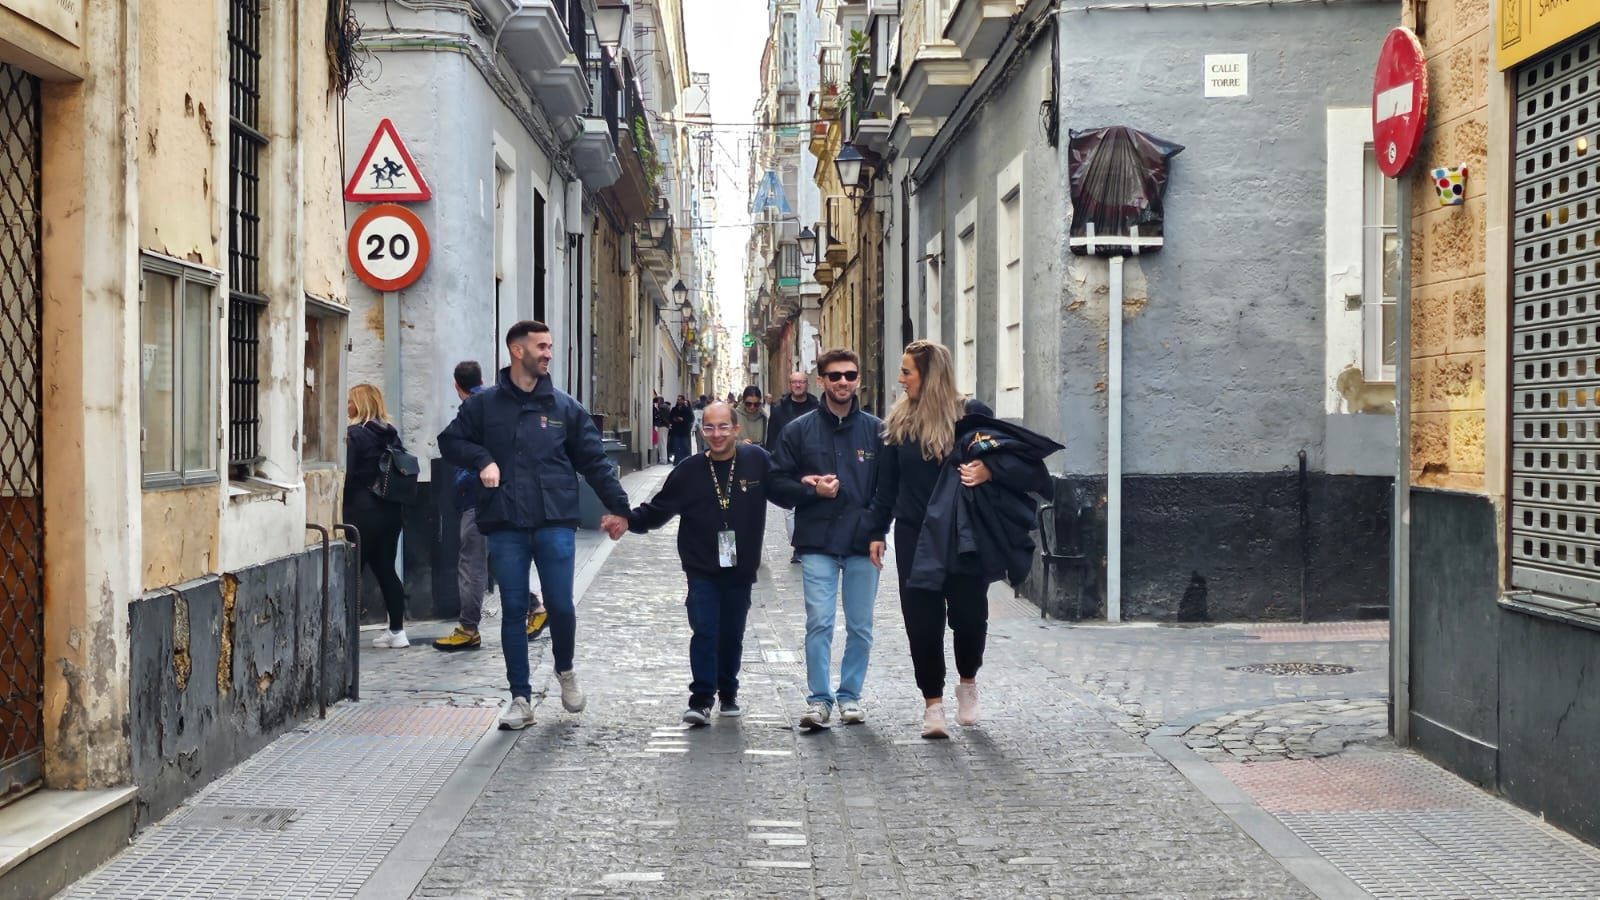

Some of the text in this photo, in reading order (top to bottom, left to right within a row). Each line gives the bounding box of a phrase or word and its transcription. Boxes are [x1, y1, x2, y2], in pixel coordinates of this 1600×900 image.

[1211, 63, 1241, 73] CALLE
[1211, 78, 1241, 88] TORRE
[366, 233, 410, 260] 20
